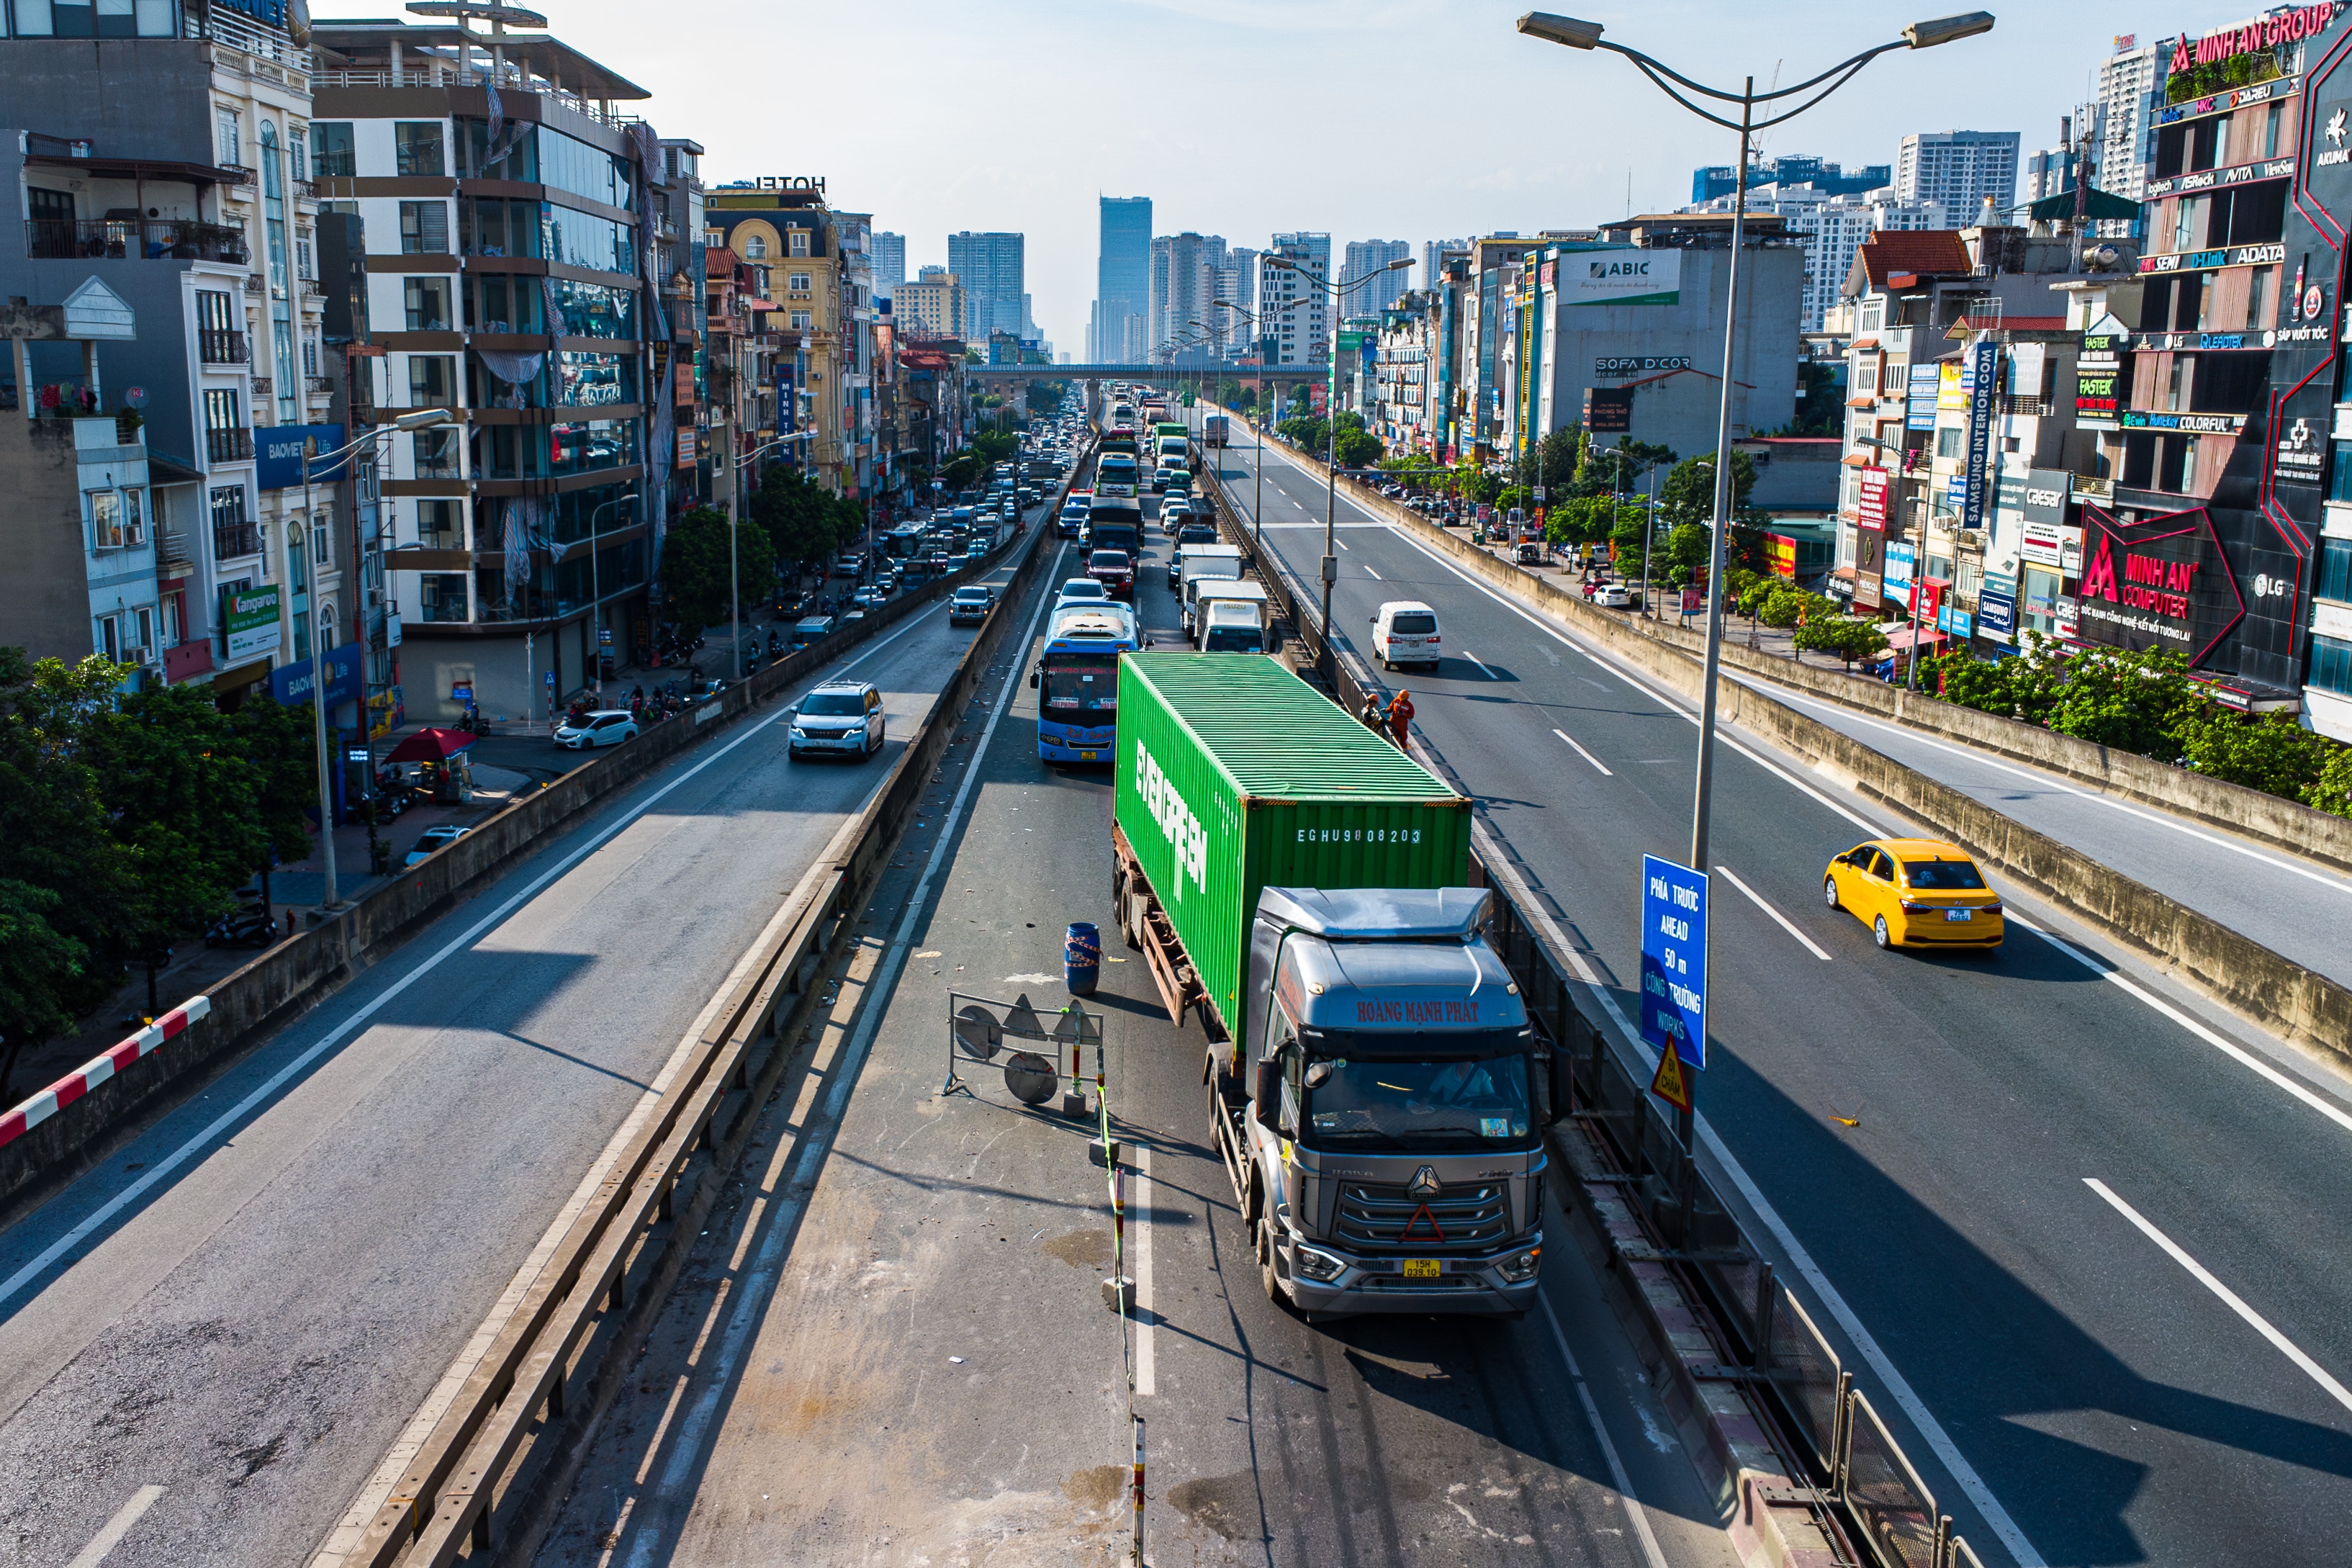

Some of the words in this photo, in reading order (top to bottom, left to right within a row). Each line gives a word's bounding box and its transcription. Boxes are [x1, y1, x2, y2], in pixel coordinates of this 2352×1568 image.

[2196, 30, 2237, 65] MINH
[2237, 22, 2263, 54] AN
[2266, 1, 2332, 47] GROUP
[2238, 85, 2271, 104] DAREU
[2196, 97, 2214, 114] HKC
[2160, 109, 2181, 124] Netac
[2181, 173, 2214, 190] ASRock
[2225, 166, 2253, 183] AVITA
[2148, 180, 2172, 197] logitech
[2191, 250, 2227, 268] D-Link
[2237, 245, 2286, 263] ADATA
[1609, 262, 1648, 275] ABIC
[843, 288, 854, 364] HOTEL
[2277, 328, 2292, 341] SÁP
[2311, 326, 2328, 338] TÓC
[2085, 336, 2110, 349] FASTER
[2173, 335, 2184, 348] LG
[1596, 359, 1638, 369] SOFA
[2080, 379, 2113, 395] FASTER
[781, 382, 790, 416] MINH
[2130, 414, 2145, 427] Ewin
[2180, 417, 2229, 431] COLORFUL
[269, 441, 304, 459] BAOVIET
[317, 438, 331, 454] Life
[2027, 487, 2063, 508] caesar
[2125, 553, 2166, 587] MINH
[2166, 562, 2191, 593] AN
[2267, 577, 2284, 597] LG
[231, 593, 277, 615] Kangaroo
[1983, 600, 2009, 618] SAMSUNG
[2123, 585, 2188, 619] COMPUTER
[2081, 603, 2091, 616] SỨC
[2091, 608, 2107, 621] MẠNH
[2107, 610, 2122, 624] CÔNG
[2179, 630, 2191, 642] LAI
[335, 662, 348, 678] Life
[1136, 736, 1207, 895] EVERGREEN
[1650, 875, 1669, 901] PHÍA
[1672, 885, 1699, 913] TRƯỚC
[1660, 914, 1689, 942] AHEAD
[1664, 947, 1676, 970] 50
[1678, 958, 1687, 975] m
[1645, 971, 1665, 998] CÔNG
[1668, 981, 1701, 1015] TRƯỜNG
[1356, 999, 1403, 1023] HOÀNG
[1405, 1001, 1443, 1026] MẠNH
[1445, 996, 1479, 1023] PHÁT
[1657, 1009, 1685, 1040] WORKS
[1407, 1268, 1437, 1276] 039.10
[1415, 1260, 1430, 1269] 15H
